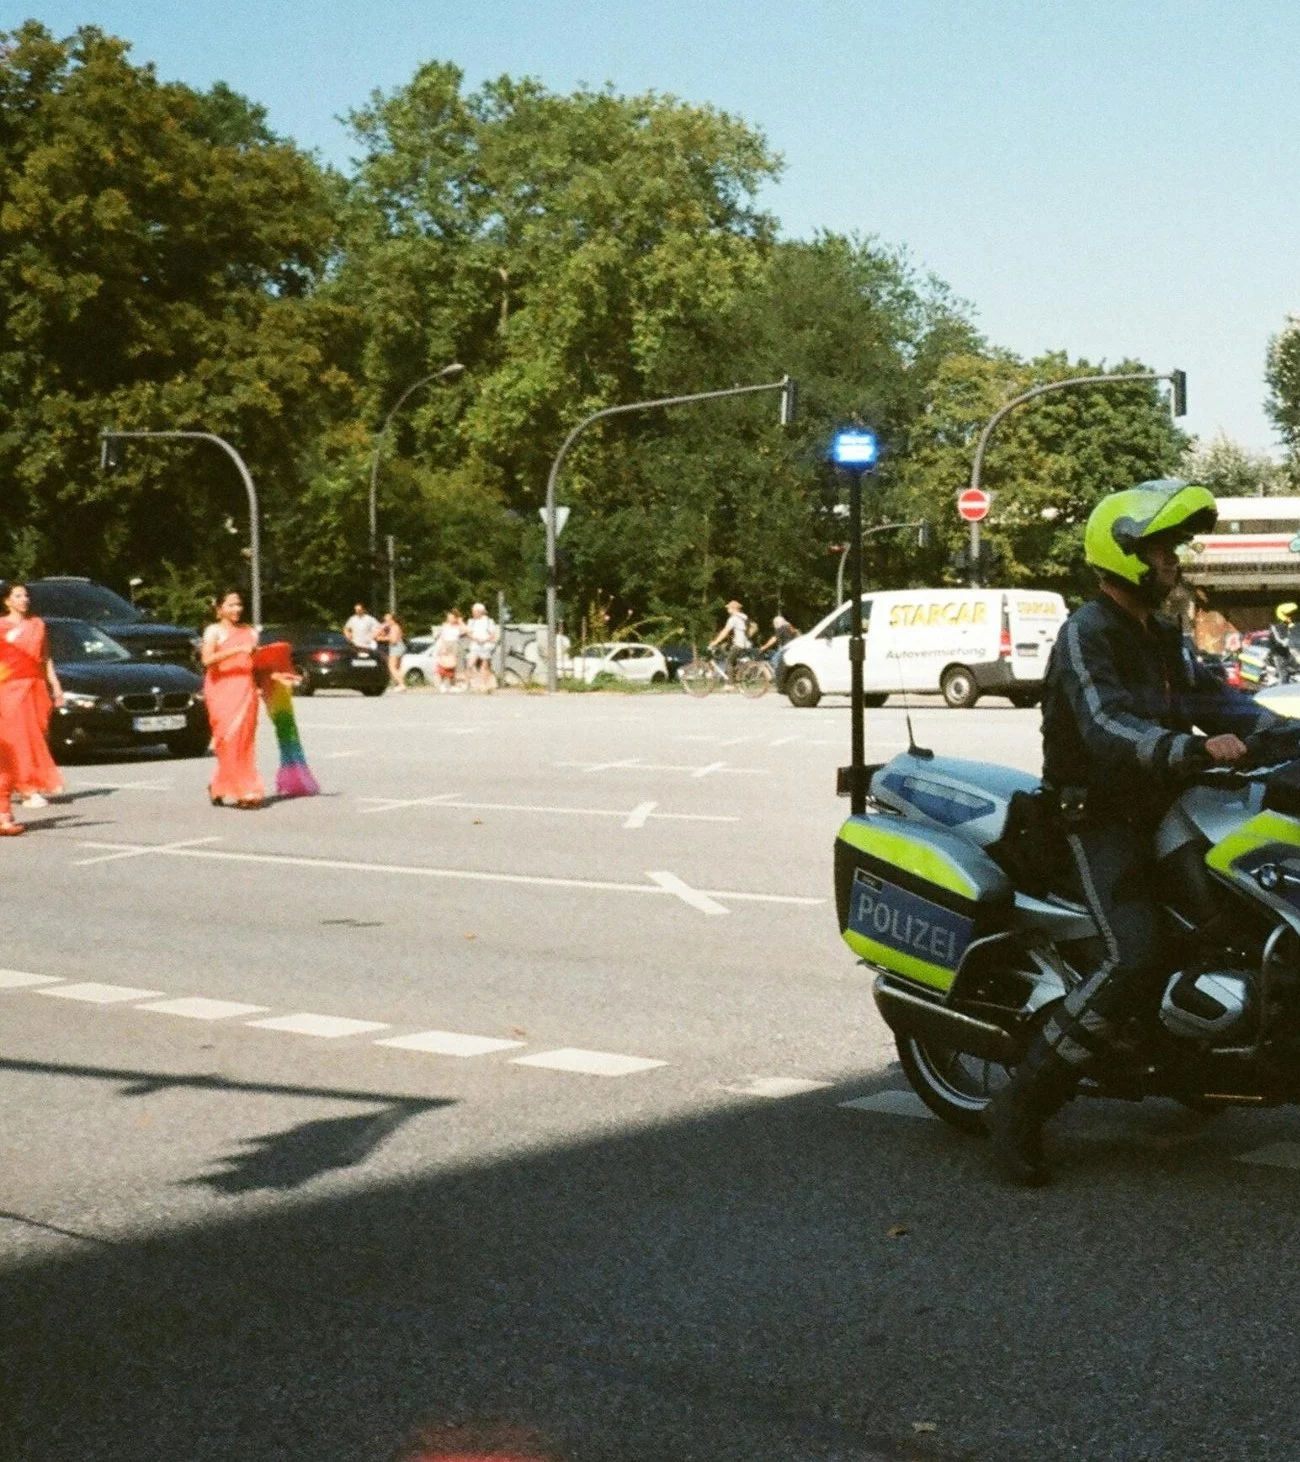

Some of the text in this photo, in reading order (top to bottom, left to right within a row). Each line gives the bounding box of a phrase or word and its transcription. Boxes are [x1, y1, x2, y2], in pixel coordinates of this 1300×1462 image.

[889, 601, 987, 628] STARCAR
[886, 647, 986, 660] Autovermietung
[857, 892, 956, 962] POLIZEI
